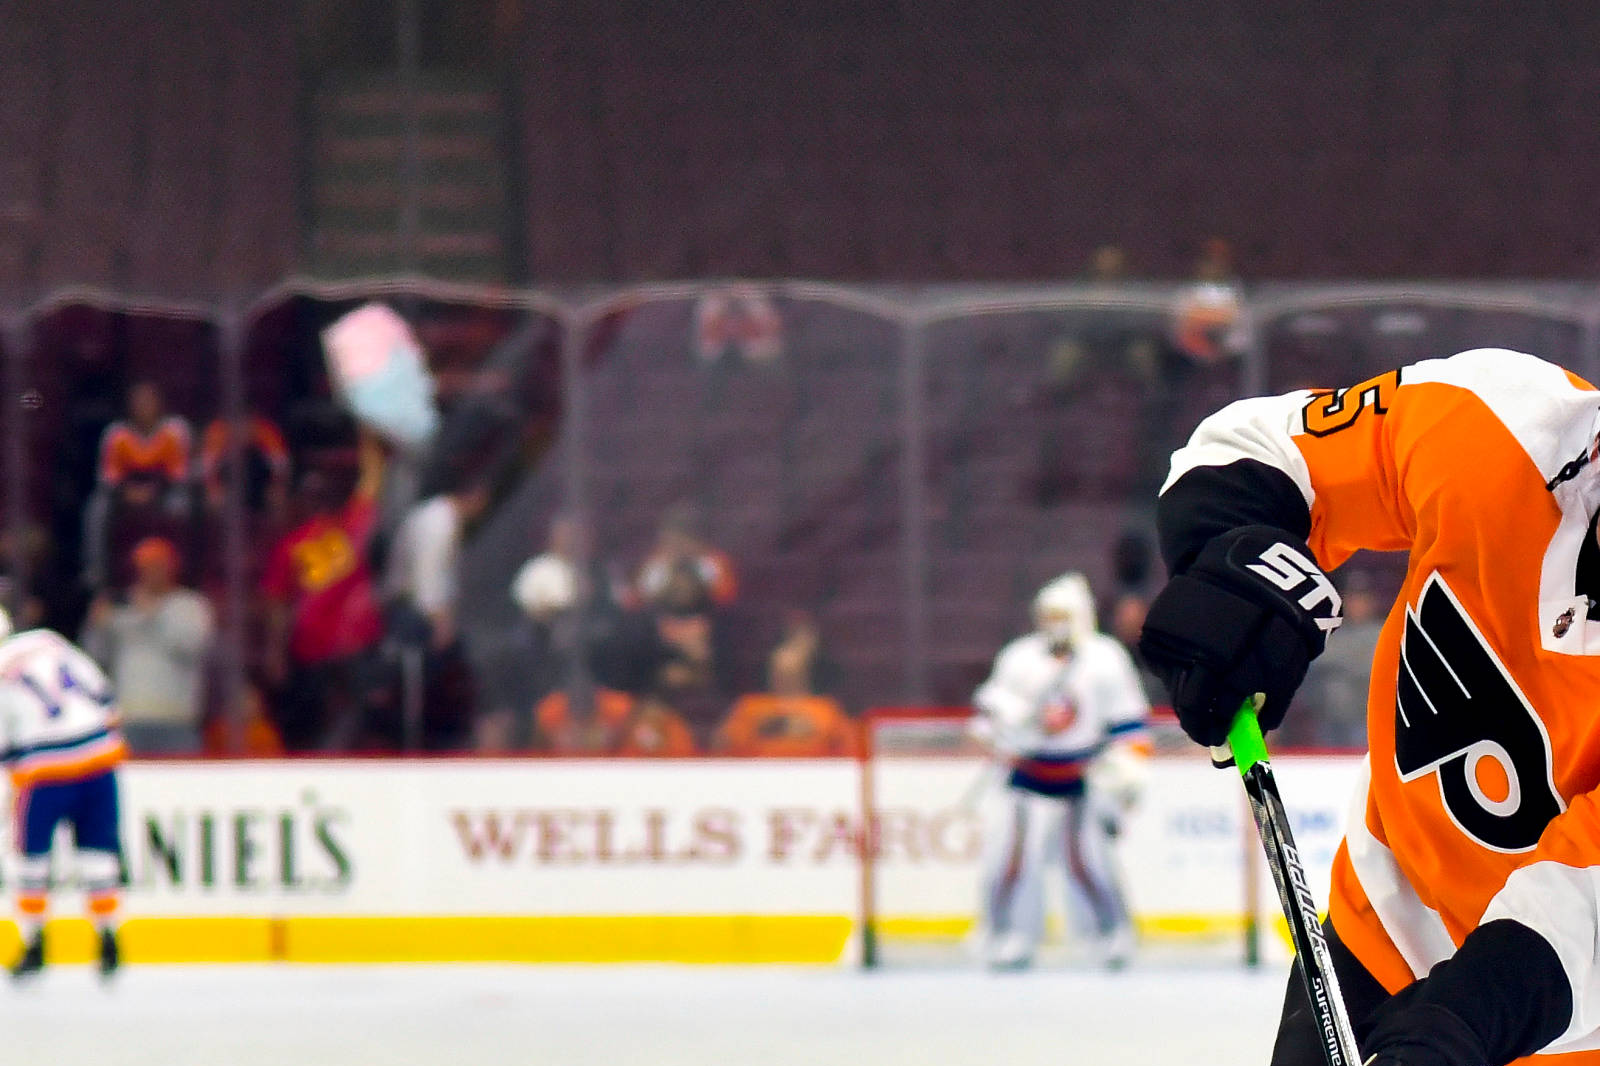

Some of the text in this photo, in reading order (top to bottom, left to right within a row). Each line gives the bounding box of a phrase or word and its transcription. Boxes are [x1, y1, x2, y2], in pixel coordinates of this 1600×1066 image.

[1245, 542, 1343, 642] STX
[450, 804, 986, 867] WELLS FARG
